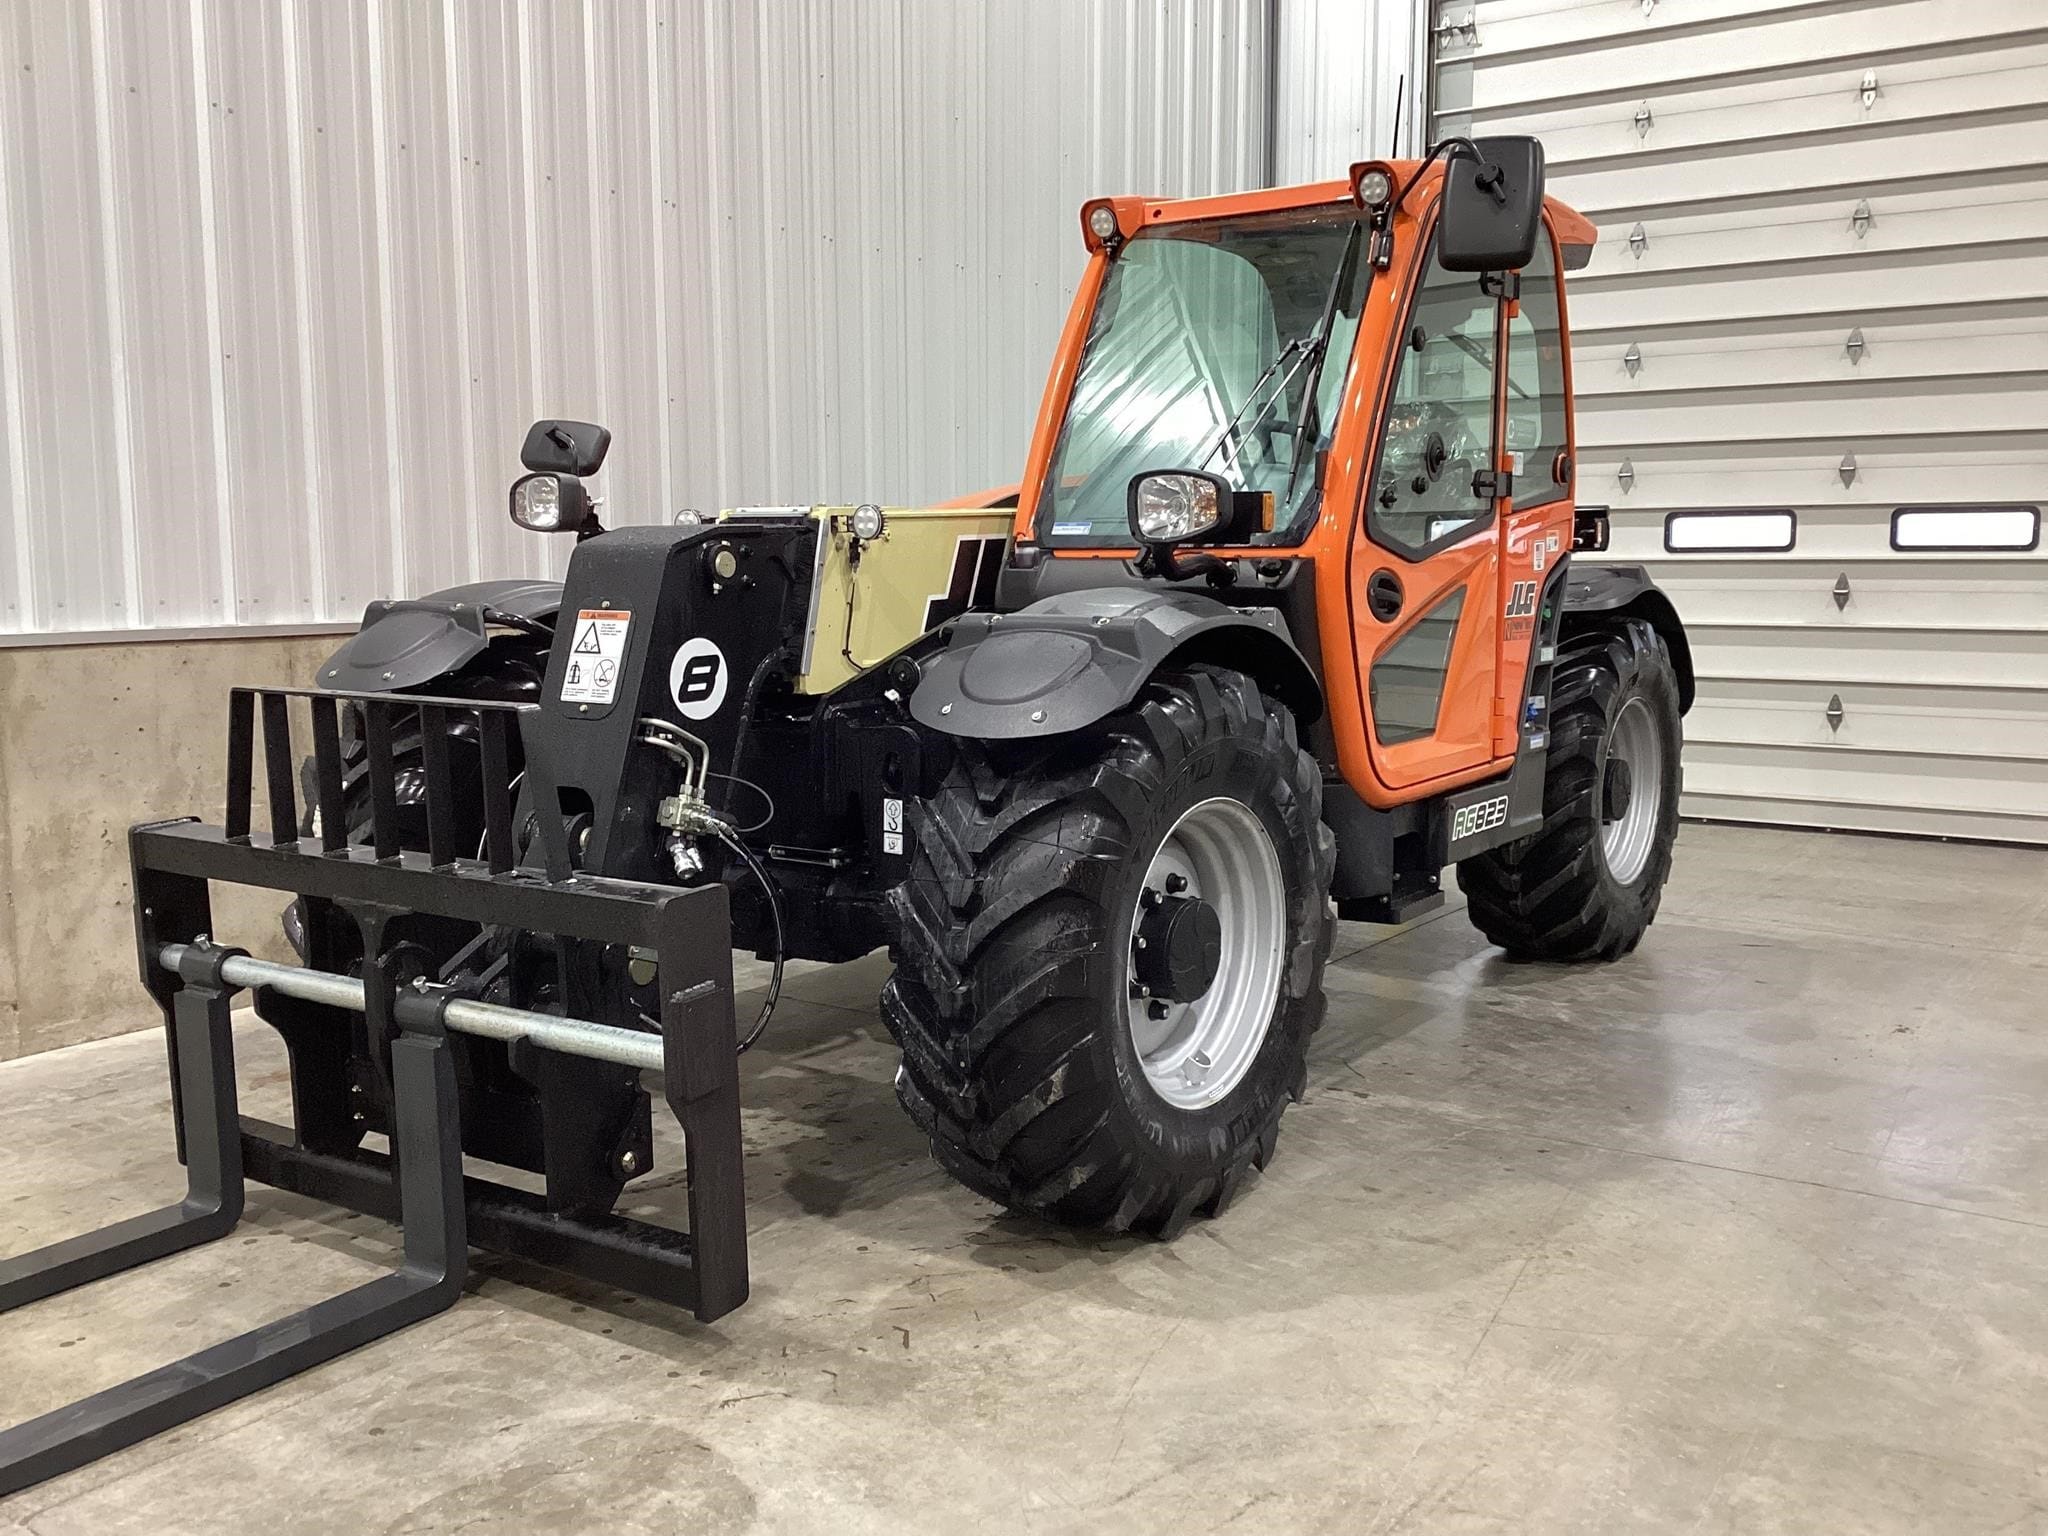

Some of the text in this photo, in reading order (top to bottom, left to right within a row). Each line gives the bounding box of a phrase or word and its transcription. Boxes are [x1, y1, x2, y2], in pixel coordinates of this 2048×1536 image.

[1505, 582, 1537, 617] JLG
[679, 655, 720, 703] 8
[1453, 796, 1508, 841] AG823
